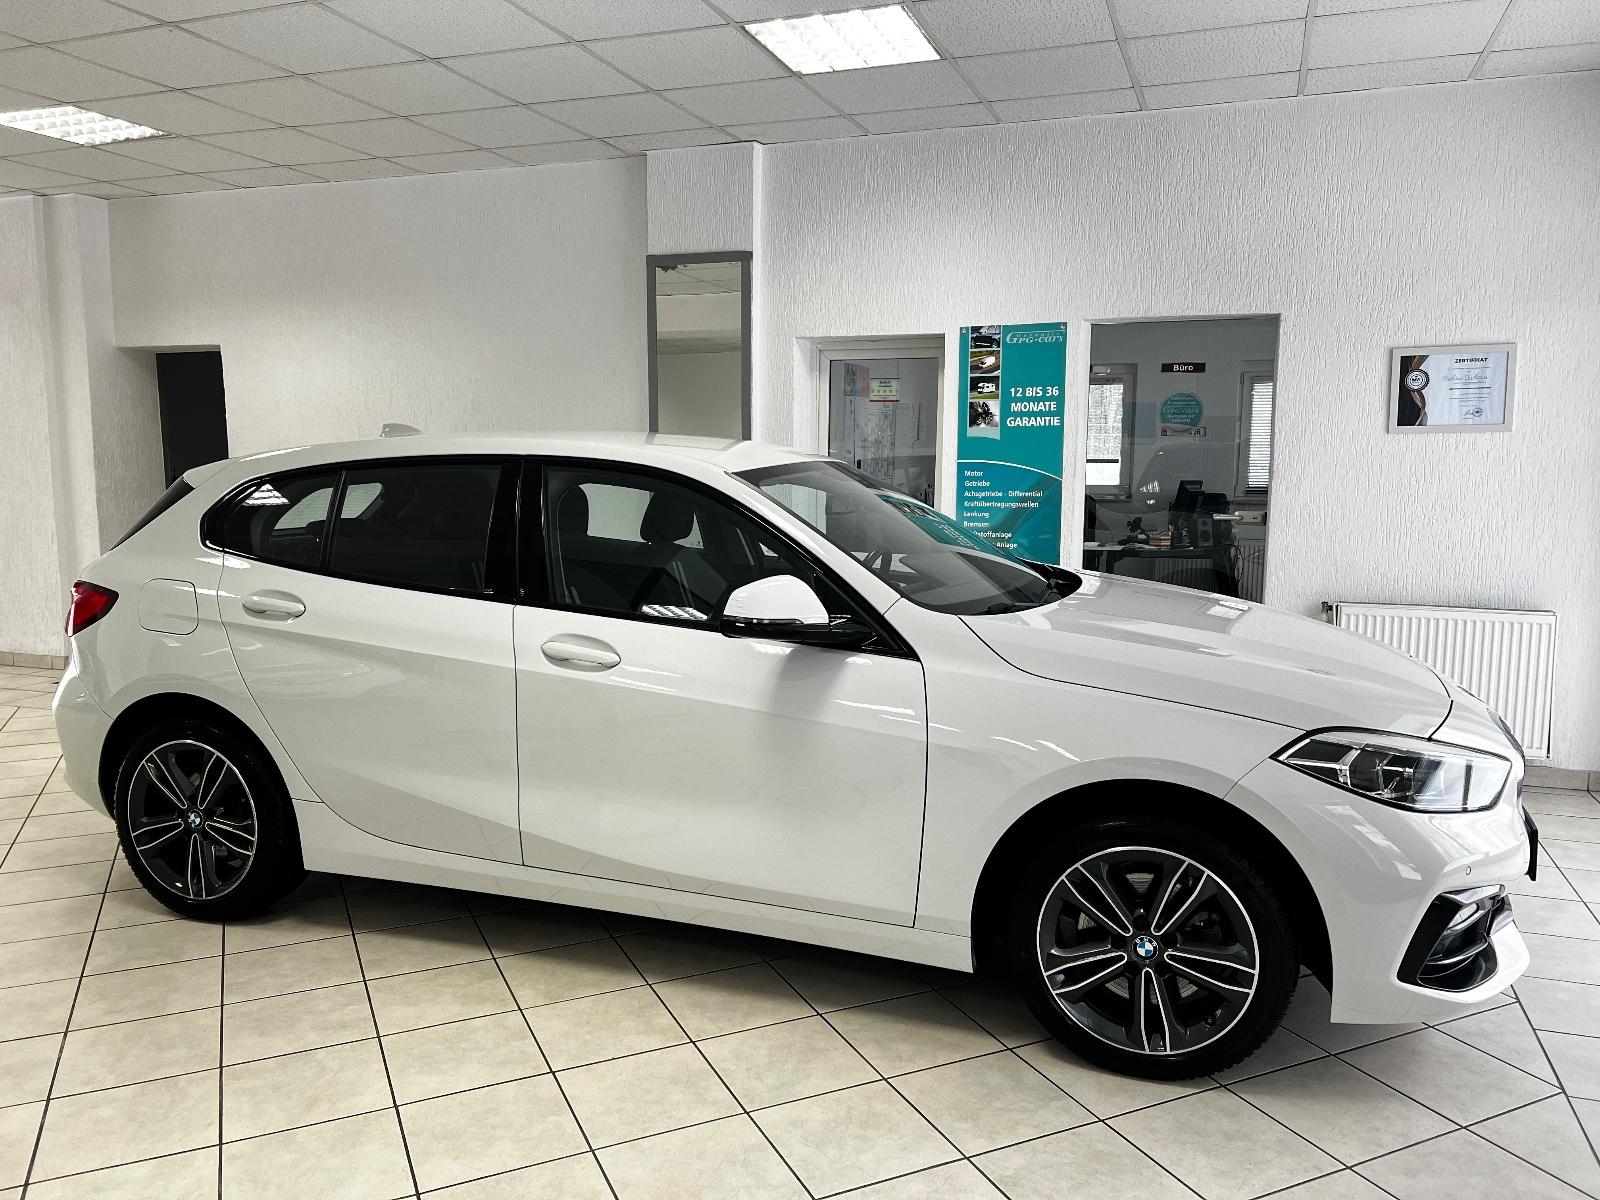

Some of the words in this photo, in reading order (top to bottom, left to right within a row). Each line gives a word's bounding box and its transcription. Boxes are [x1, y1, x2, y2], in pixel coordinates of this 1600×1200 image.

[1010, 387, 1022, 397] 12
[1026, 387, 1043, 397] BIS
[1045, 386, 1059, 396] 36
[1010, 401, 1057, 412] MONATE
[1006, 416, 1061, 427] GARANTIE
[963, 490, 1003, 498] Achsgetriebe
[963, 500, 1039, 508] Kraftübertragungswellen
[996, 541, 1018, 550] Anlage
